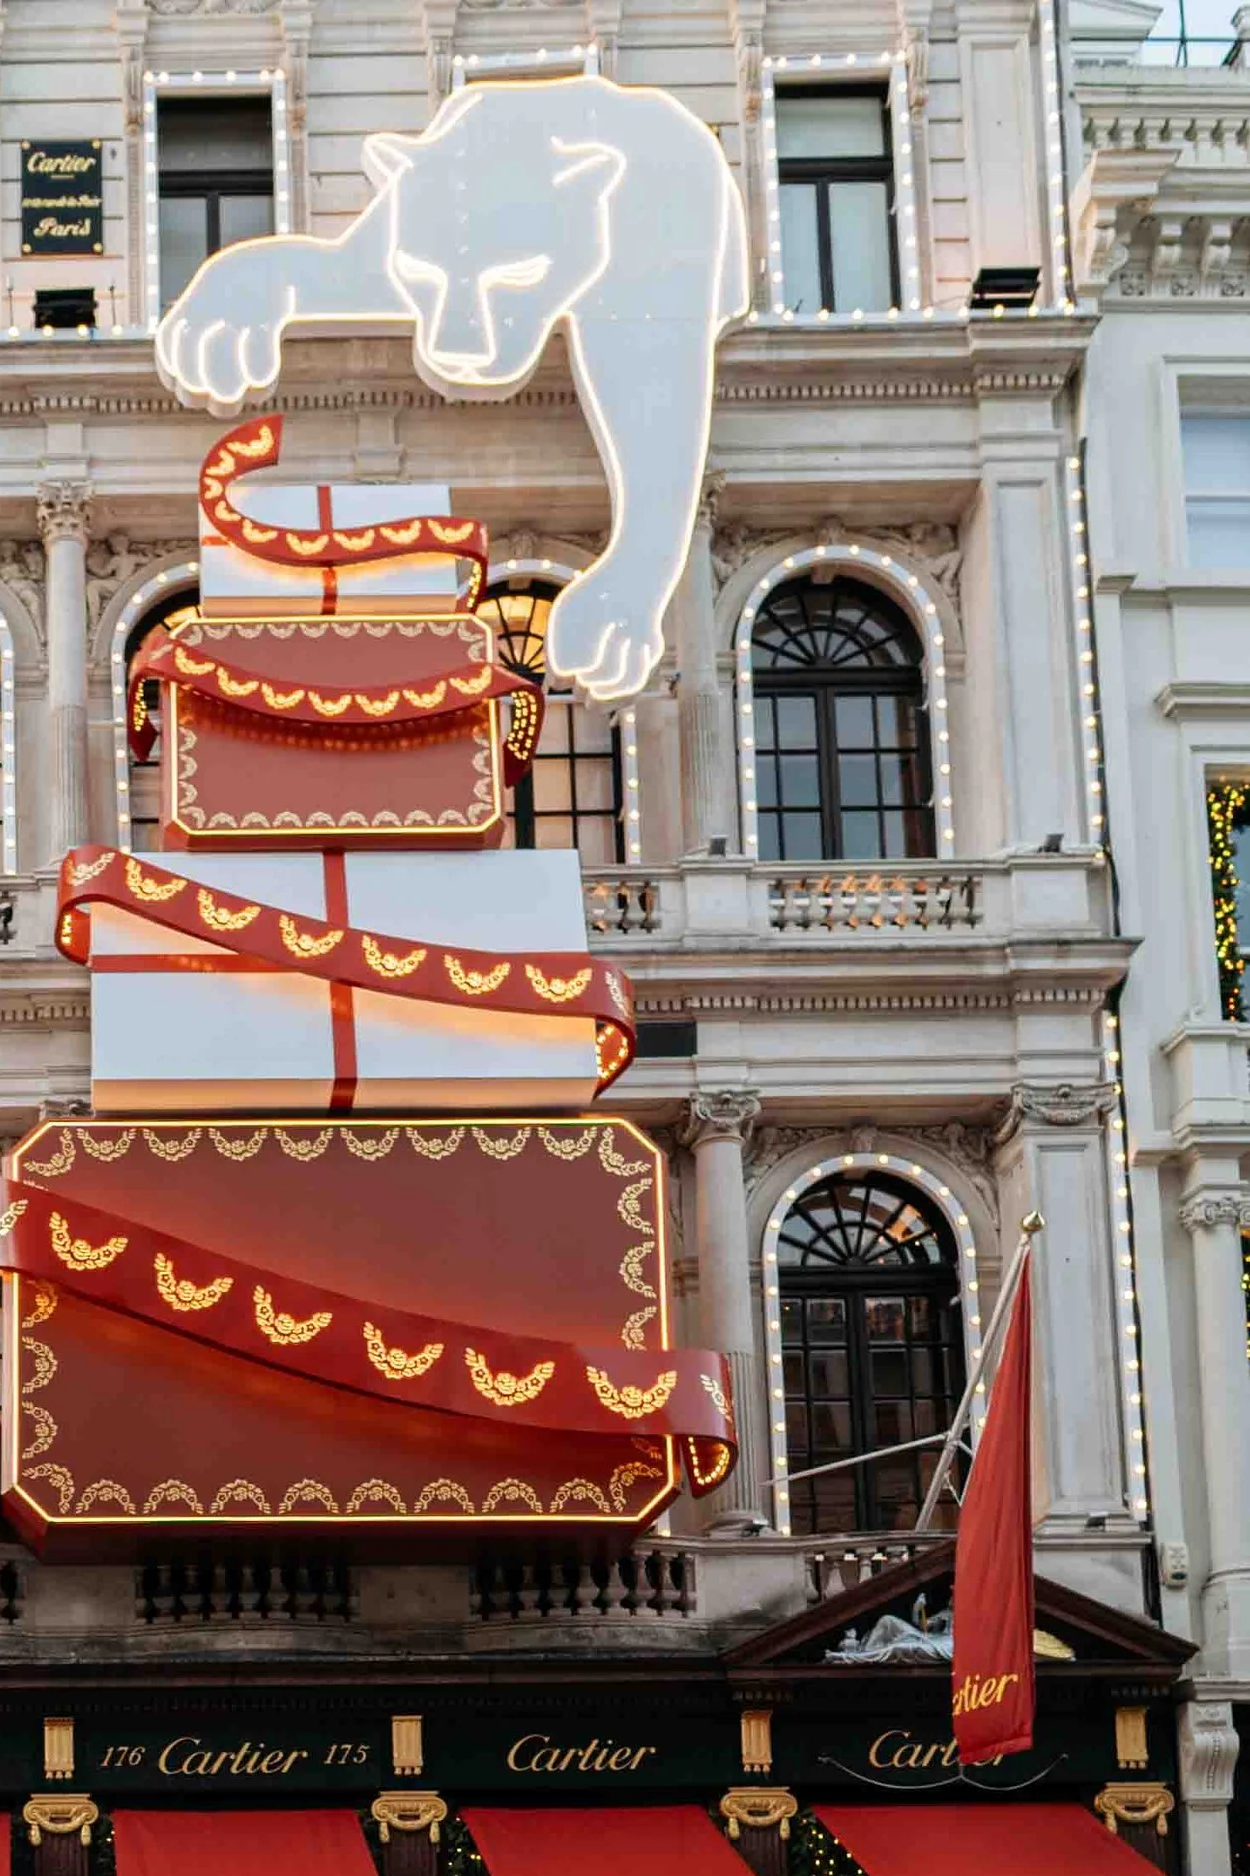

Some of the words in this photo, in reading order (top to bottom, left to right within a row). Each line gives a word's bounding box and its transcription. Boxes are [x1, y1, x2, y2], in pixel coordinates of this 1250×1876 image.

[27, 151, 96, 173] Cartier
[100, 1746, 146, 1767] 176
[158, 1736, 309, 1775] Cartier
[323, 1743, 370, 1765] 175
[506, 1733, 656, 1772] Cartier
[868, 1729, 1004, 1768] Cart
